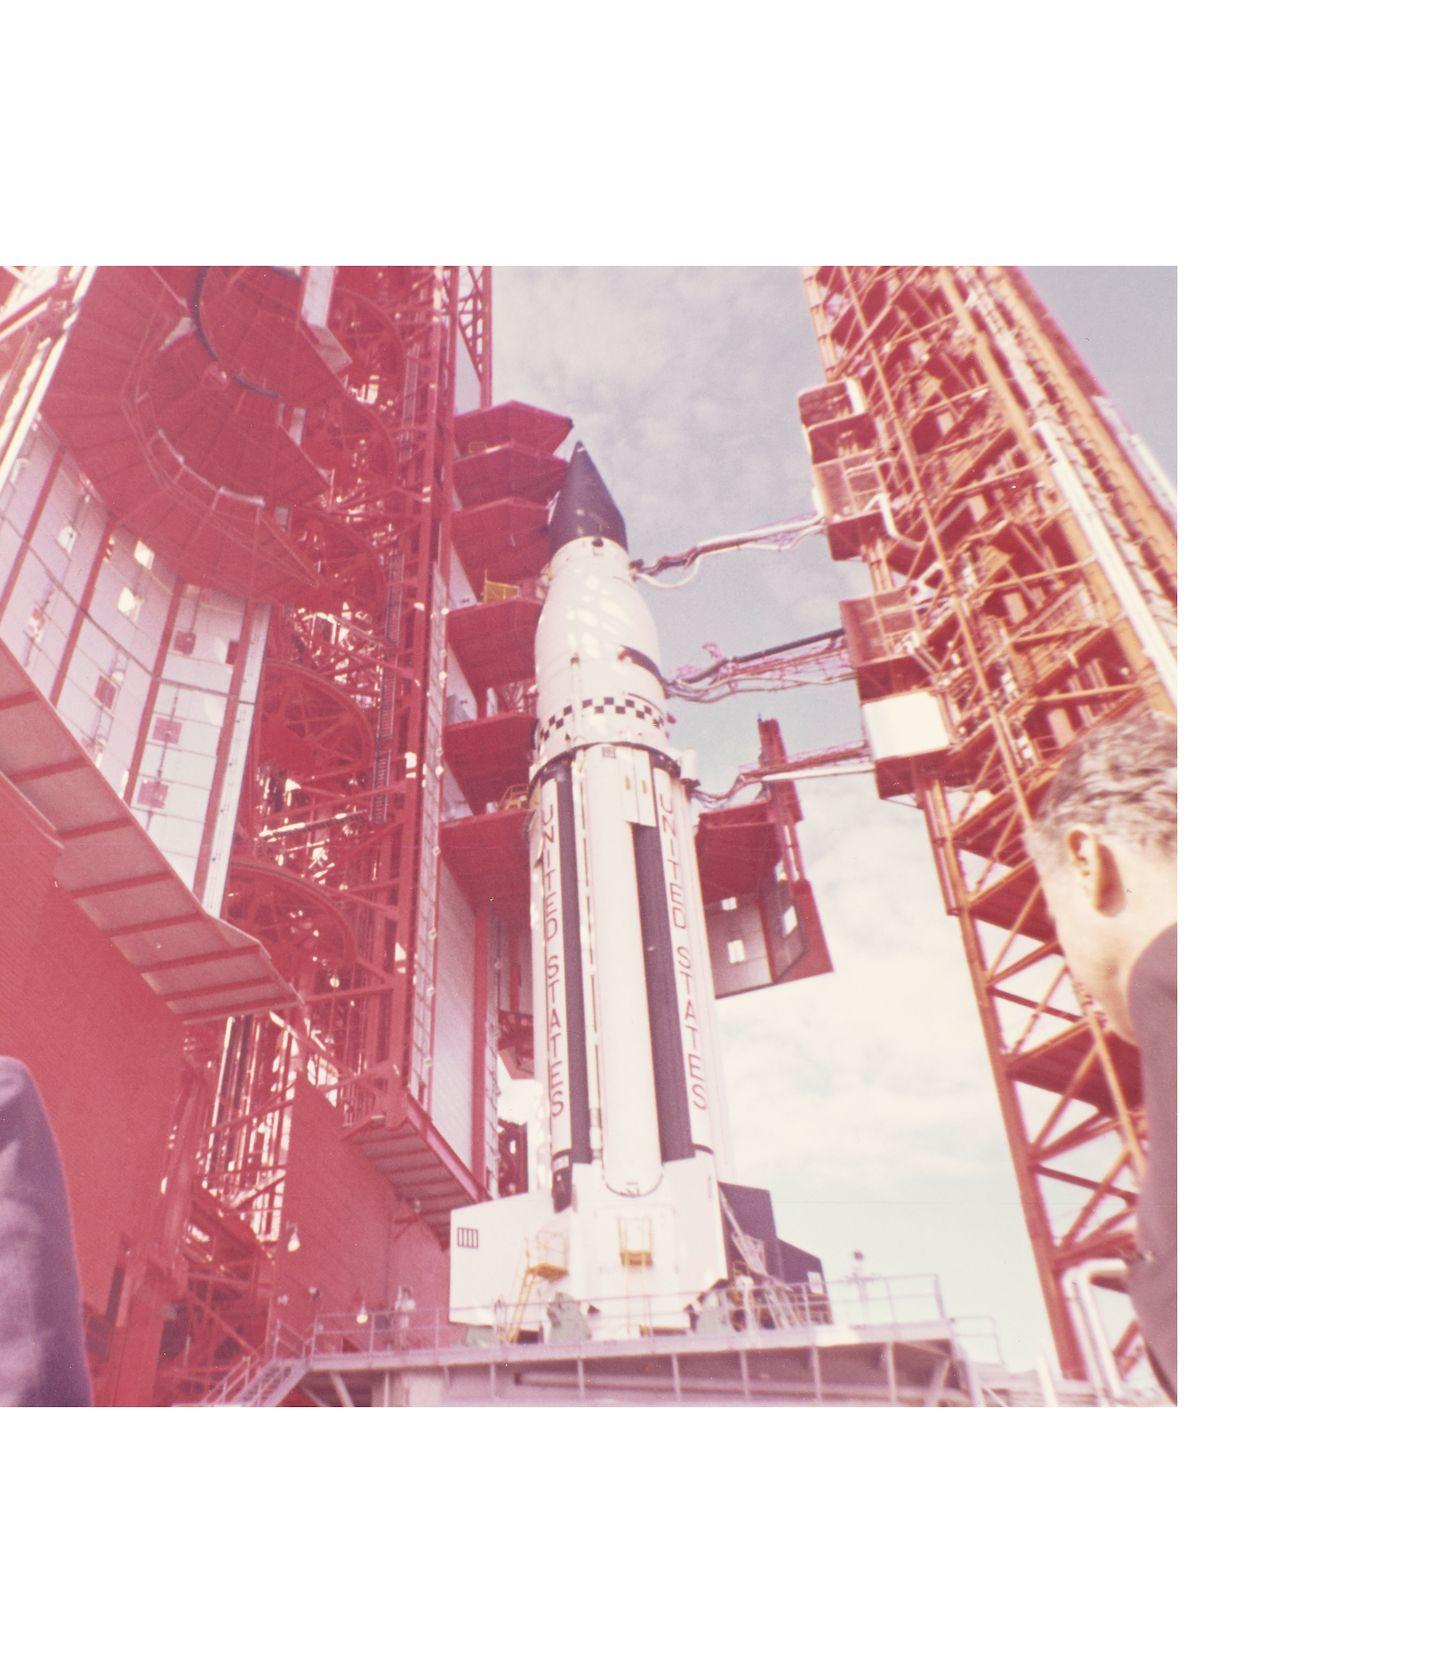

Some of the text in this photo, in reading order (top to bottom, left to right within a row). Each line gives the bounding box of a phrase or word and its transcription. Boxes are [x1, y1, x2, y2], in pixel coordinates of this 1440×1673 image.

[541, 803, 564, 1118] UNITED STATES
[659, 792, 708, 1111] UNITED STATES
